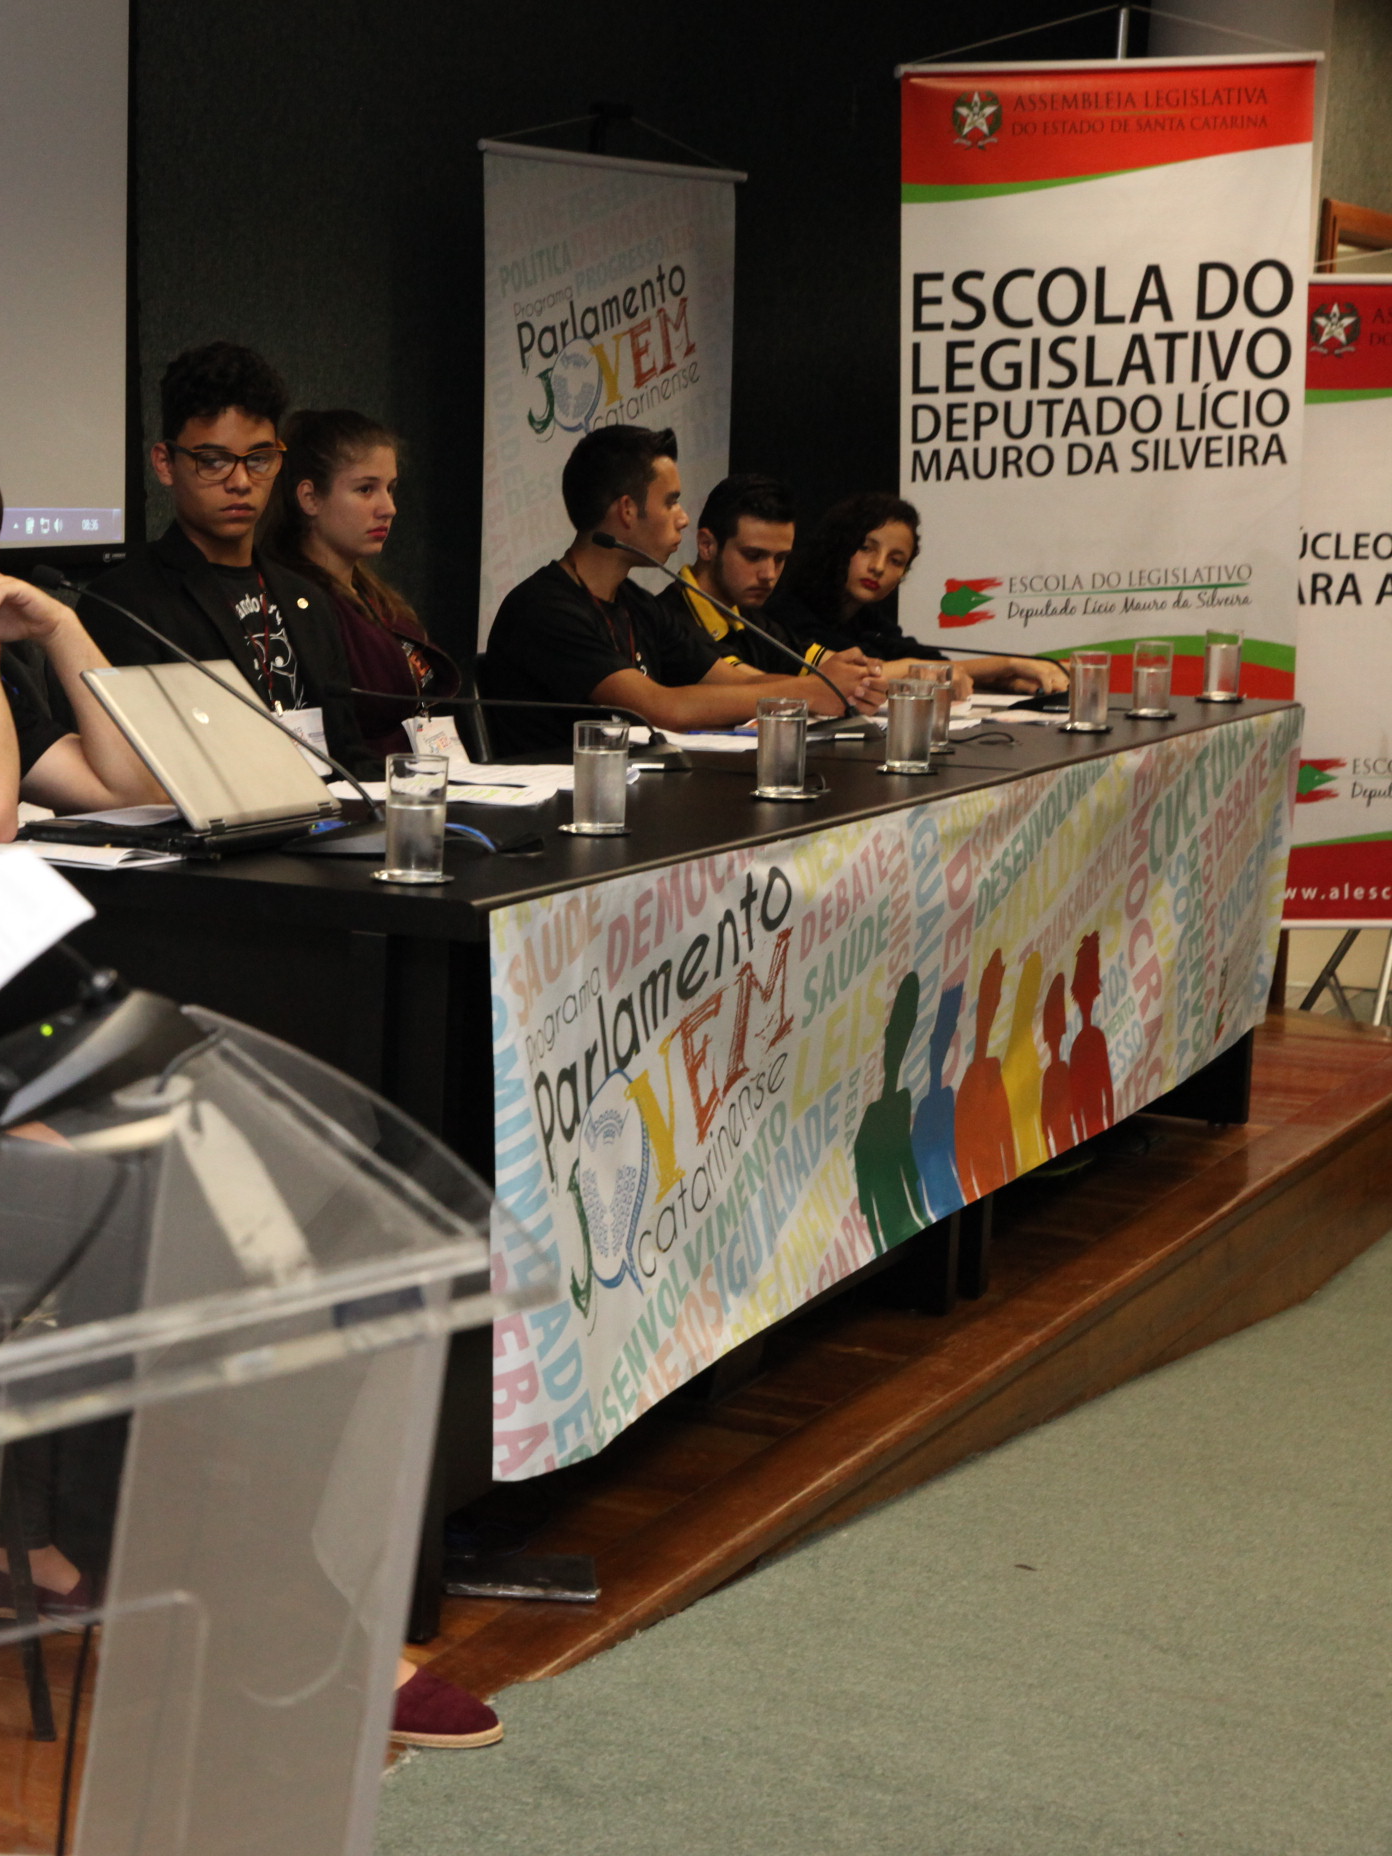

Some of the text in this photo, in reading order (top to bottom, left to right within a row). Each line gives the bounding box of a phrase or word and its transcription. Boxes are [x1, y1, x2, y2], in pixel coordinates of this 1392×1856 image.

[1011, 114, 1269, 136] DO ESTADO DE SANTA CATARINA
[1012, 87, 1269, 112] ASSEMBLEIA LEGISLATIVA
[513, 285, 574, 321] Programa
[516, 263, 686, 370] Parlamento
[912, 259, 1294, 333] ESCOLA DO
[527, 296, 698, 436] JOVEM
[592, 360, 702, 428] catarinense
[911, 326, 1293, 396] LEGISLATIVO
[911, 381, 1291, 445] DEPUTADO LÍCIO
[911, 433, 1288, 483] MAURO DA SILVEIRA
[1007, 562, 1253, 593] ESCOLA DO LEGISLATIVO
[1007, 598, 1077, 628] Deputado
[1120, 596, 1167, 614] Mauro
[1172, 593, 1192, 609] da
[1197, 589, 1253, 609] Silveira
[1149, 719, 1256, 876] CULTURA
[799, 829, 889, 963] DEBATE
[801, 894, 891, 1029] SAÚDE
[524, 965, 602, 1066] Programa
[534, 864, 793, 1184] Parlamento
[795, 961, 886, 1121] LEIS
[568, 926, 794, 1324] JOVEM
[637, 1051, 789, 1279] catarinense
